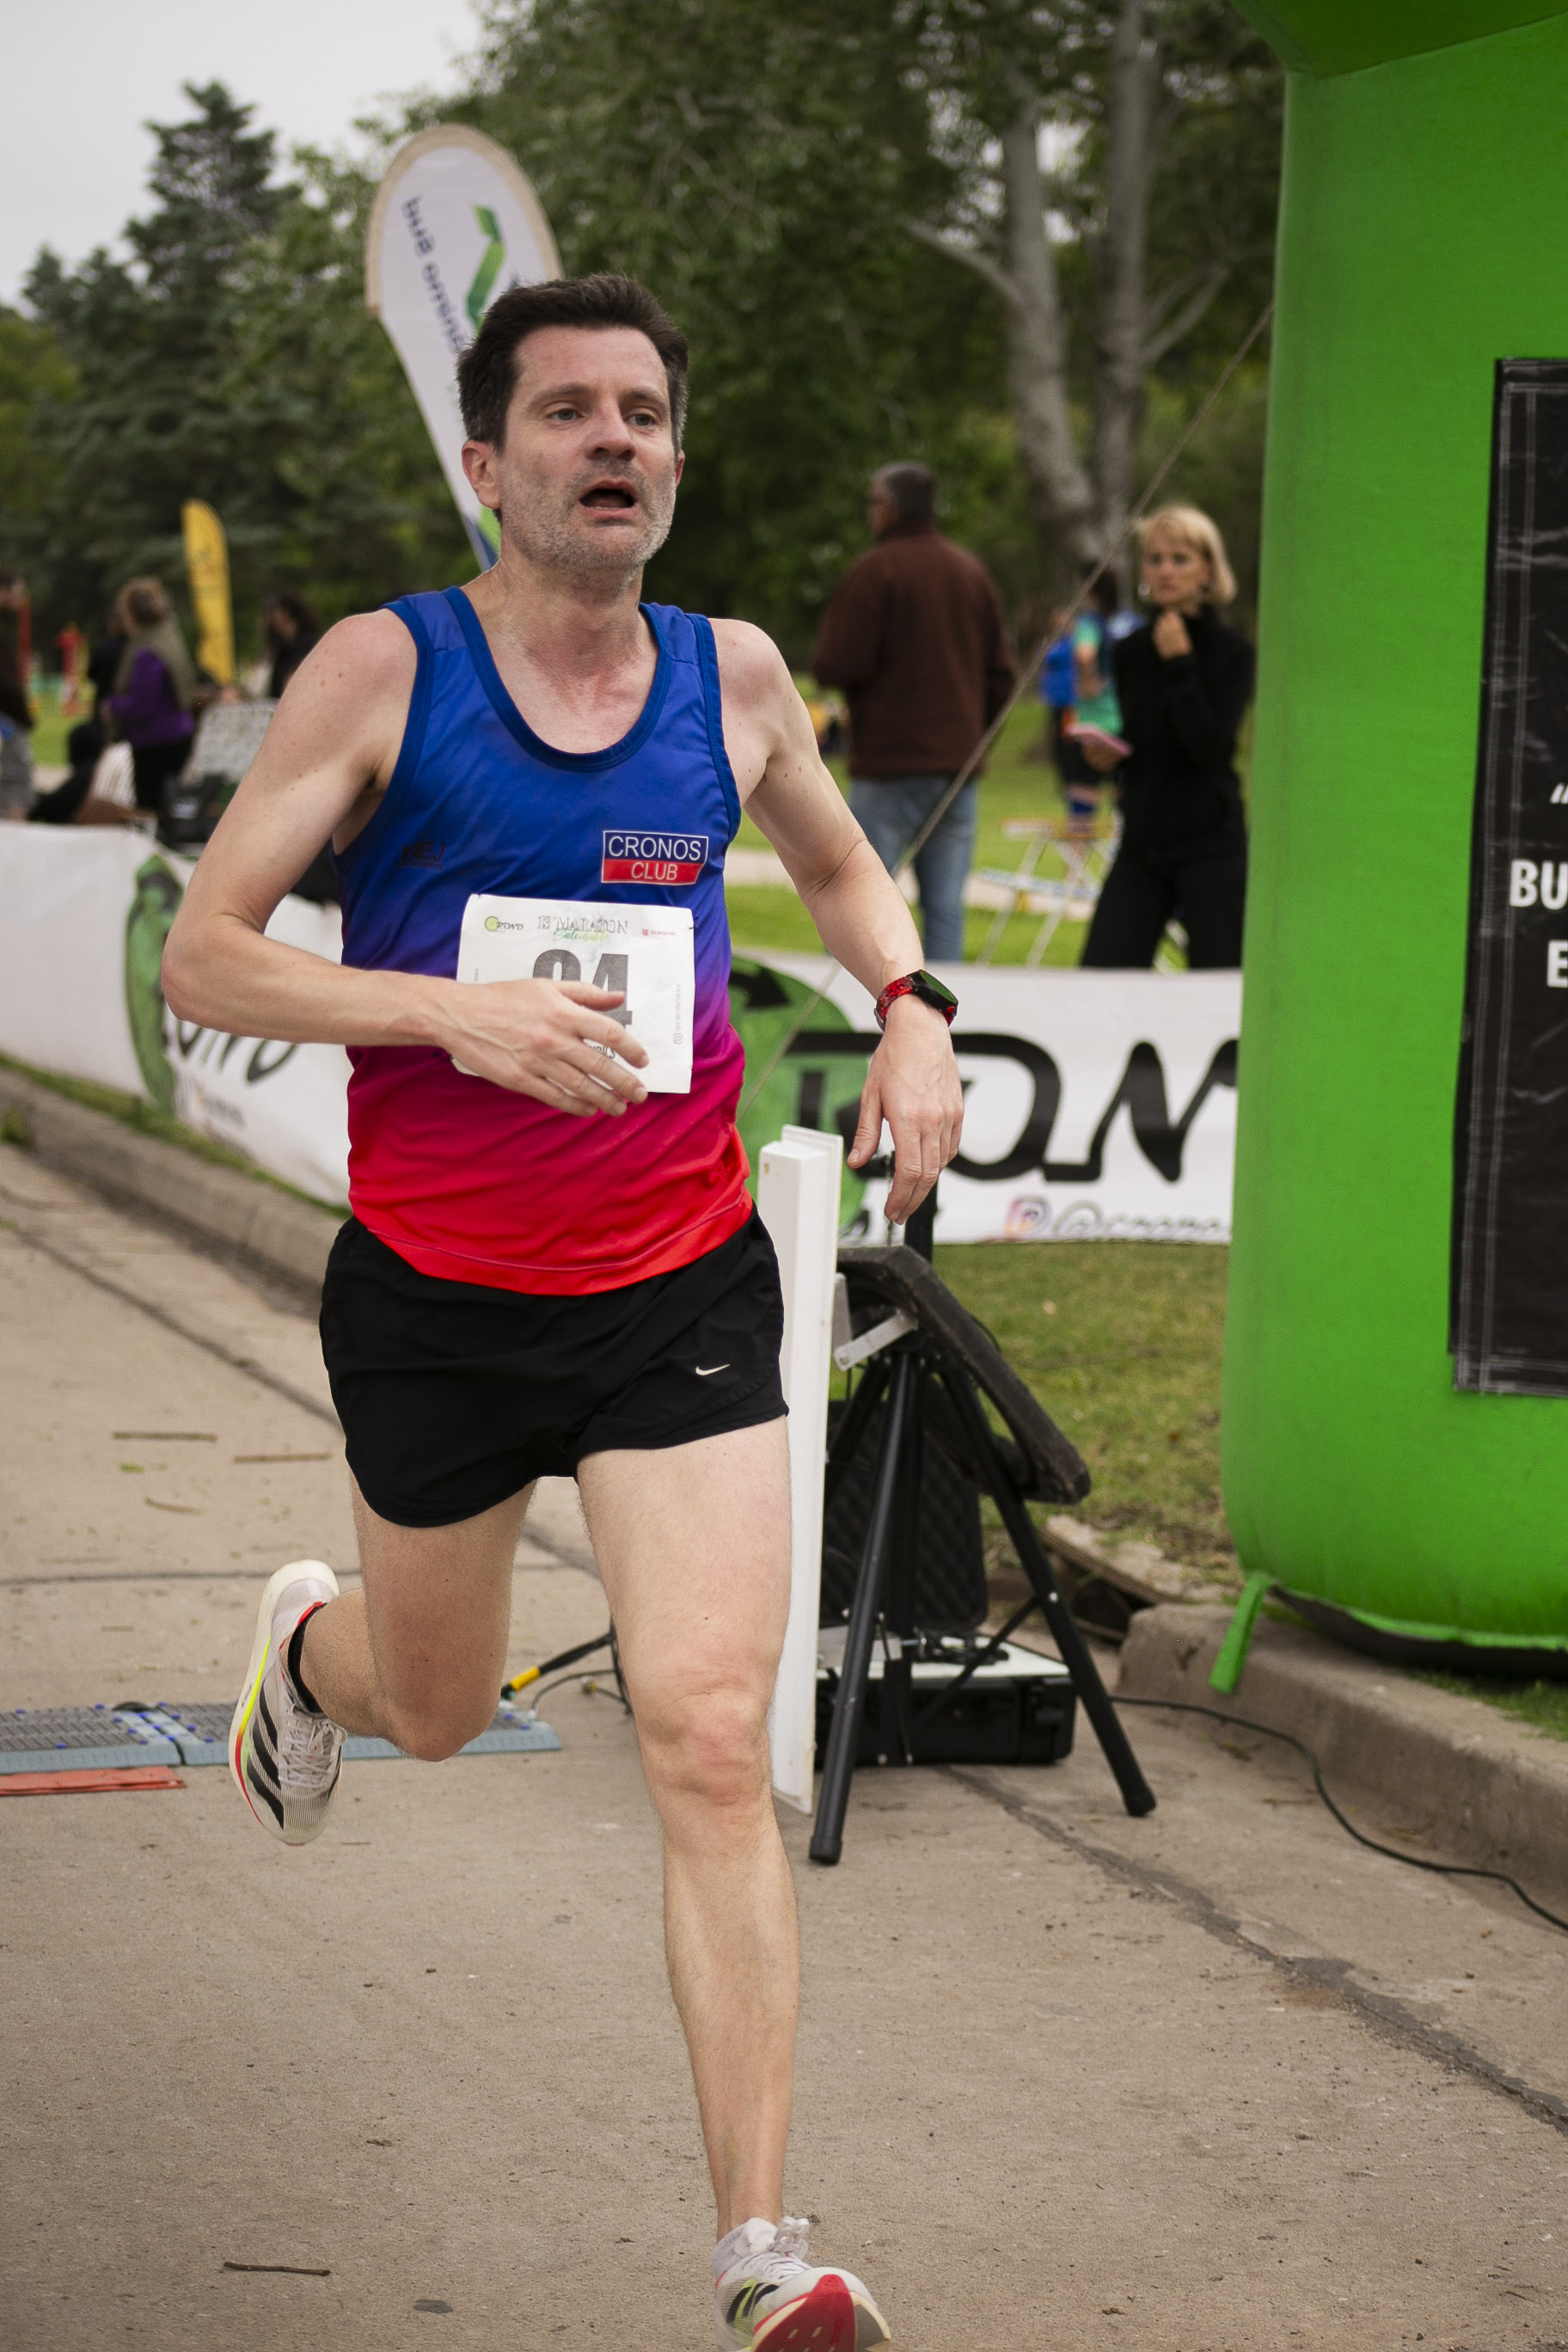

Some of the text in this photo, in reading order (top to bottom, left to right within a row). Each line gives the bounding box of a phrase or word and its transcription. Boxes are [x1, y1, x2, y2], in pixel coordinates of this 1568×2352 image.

[609, 836, 701, 861] CRONOS
[631, 861, 678, 881] CLUB
[1510, 859, 1568, 910] BU
